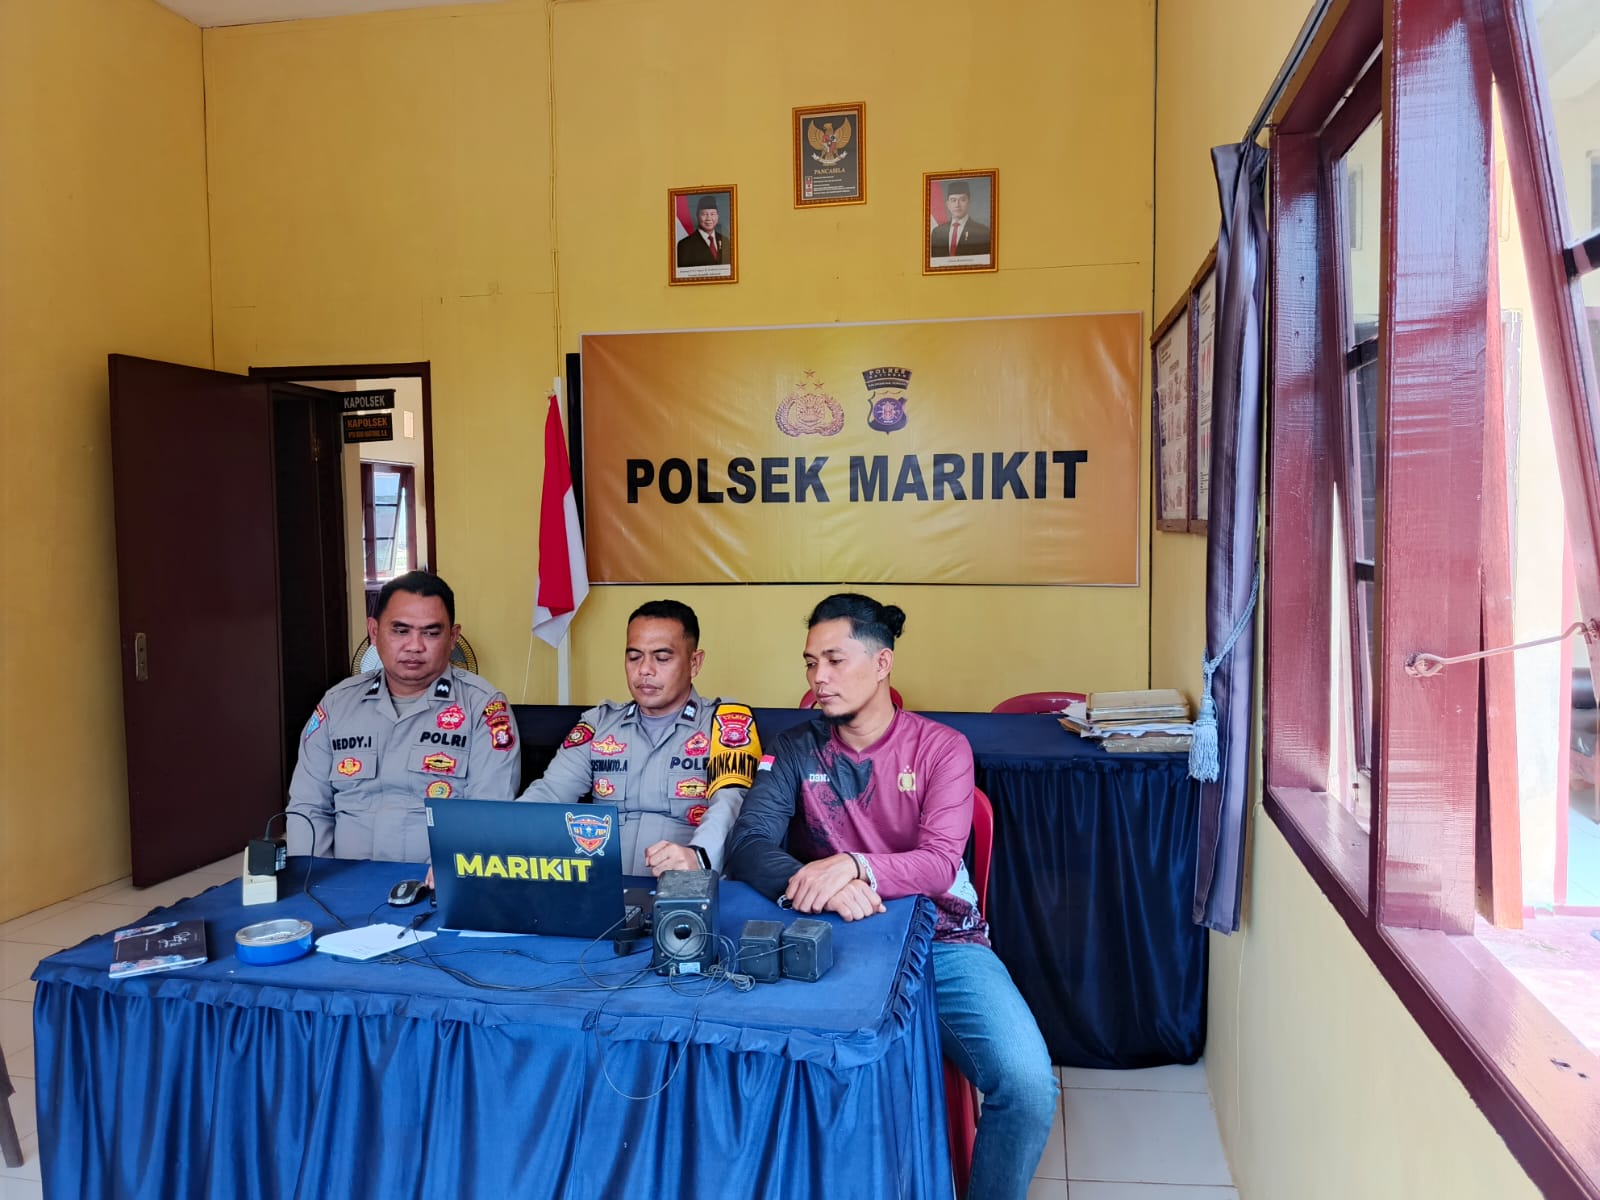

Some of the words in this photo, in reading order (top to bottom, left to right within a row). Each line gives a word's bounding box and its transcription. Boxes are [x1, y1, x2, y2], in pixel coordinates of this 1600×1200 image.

[343, 395, 385, 409] KAPOLSEK
[347, 417, 388, 428] KAPOLSEK
[626, 456, 829, 504] POLSEK
[849, 450, 1088, 502] MARIKIT
[419, 731, 467, 748] POLRI
[455, 853, 592, 882] MARIKIT
